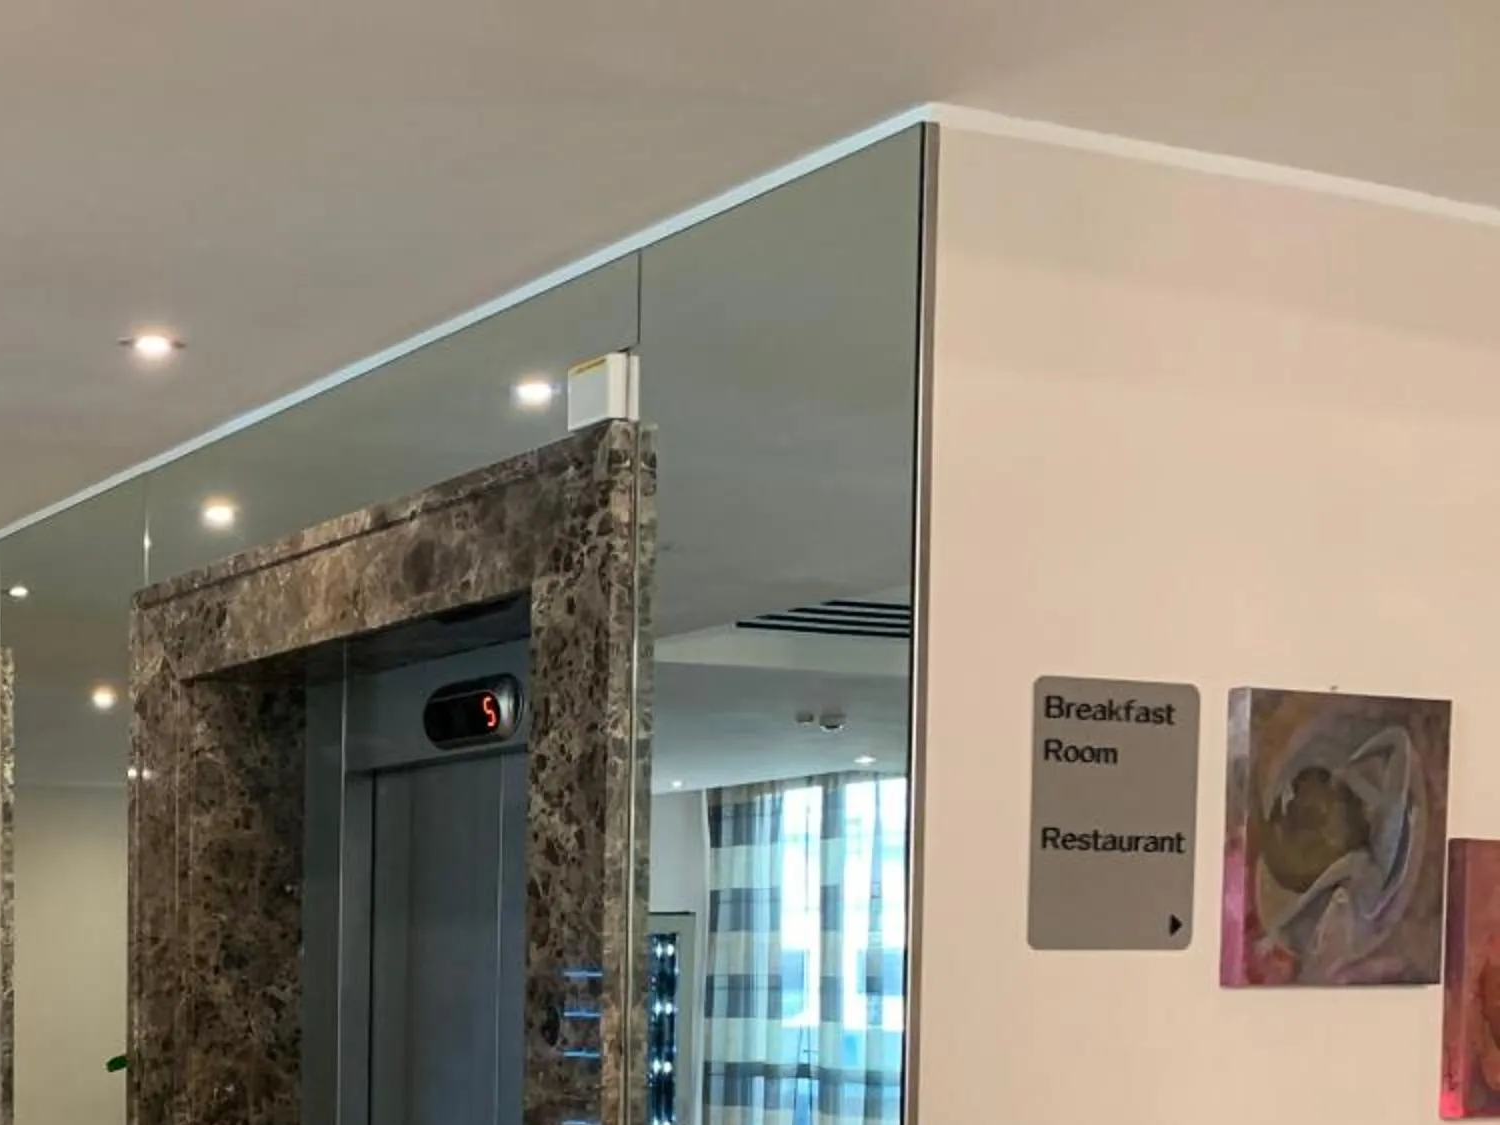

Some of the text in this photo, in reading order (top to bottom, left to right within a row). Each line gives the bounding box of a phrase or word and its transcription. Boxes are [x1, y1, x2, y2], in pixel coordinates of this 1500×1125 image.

[483, 696, 497, 727] 5
[1044, 695, 1176, 726] Breakfast
[1043, 738, 1119, 765] Room
[1041, 827, 1186, 854] Restaurant
